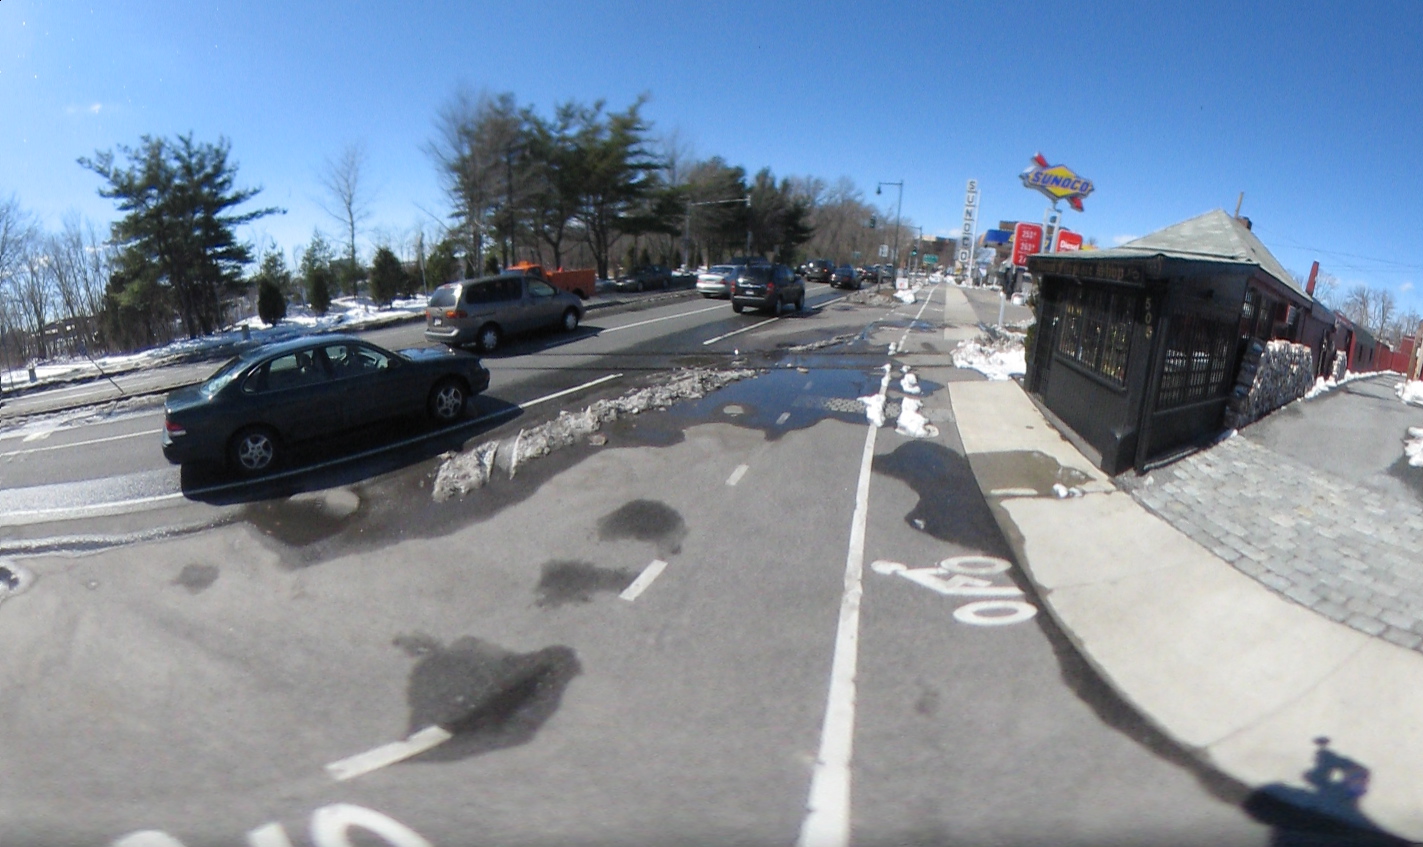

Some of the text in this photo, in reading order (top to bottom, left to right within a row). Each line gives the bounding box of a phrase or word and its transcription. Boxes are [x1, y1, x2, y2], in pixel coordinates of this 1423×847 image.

[1031, 171, 1090, 193] SUNOCO
[960, 180, 976, 262] SUNOCO
[1060, 240, 1080, 252] Diesel
